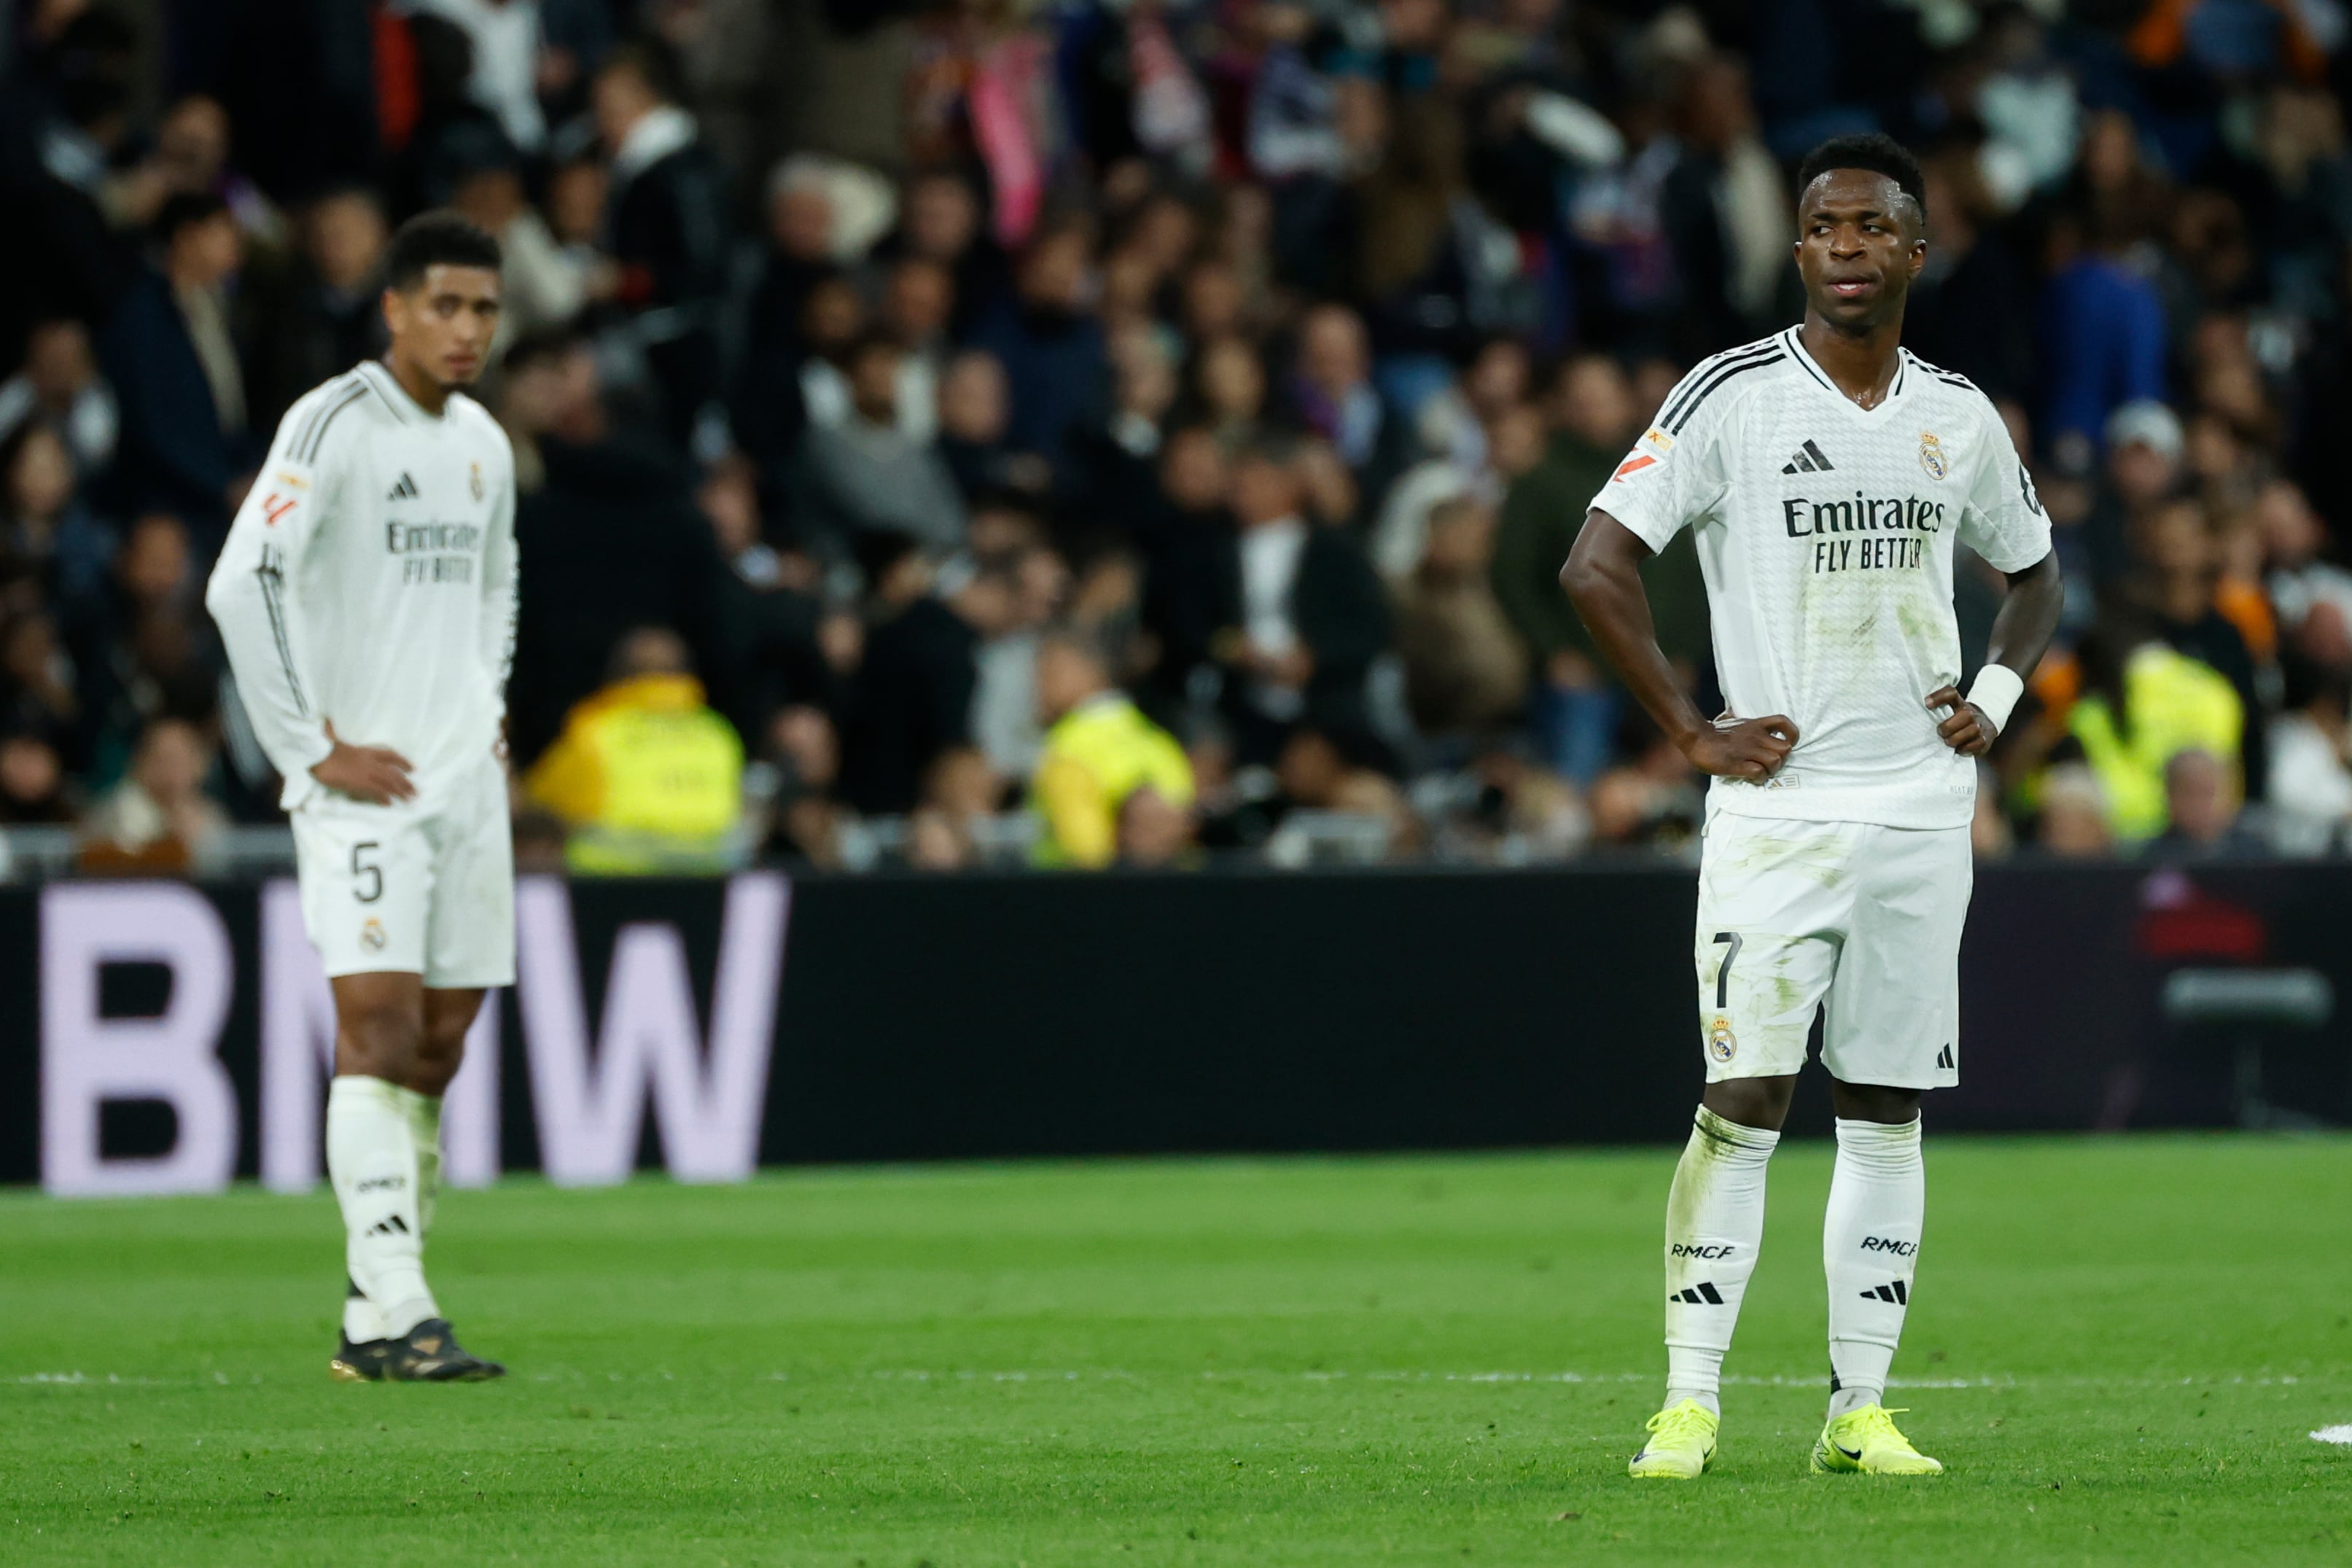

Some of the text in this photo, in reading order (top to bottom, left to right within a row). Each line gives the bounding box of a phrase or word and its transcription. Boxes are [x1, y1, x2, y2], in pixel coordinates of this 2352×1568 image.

[1782, 490, 1945, 538] Emirates
[1815, 538, 1921, 574] FLY BETTER
[352, 841, 383, 902] 5
[1713, 932, 1743, 1009] 7
[1671, 1244, 1735, 1259] RMCF
